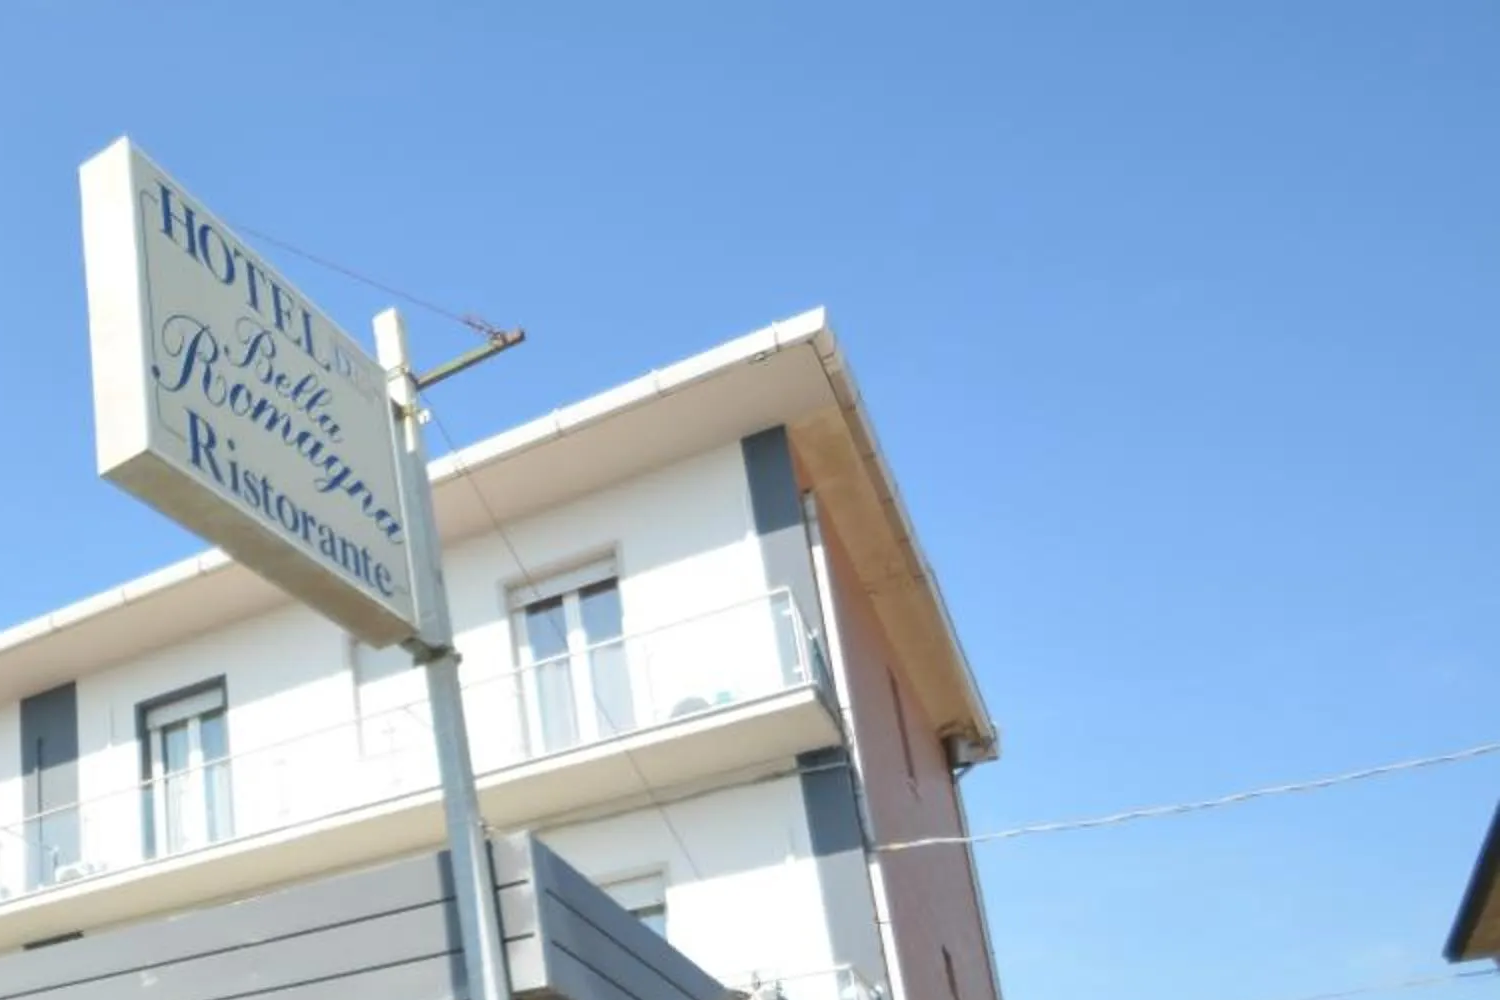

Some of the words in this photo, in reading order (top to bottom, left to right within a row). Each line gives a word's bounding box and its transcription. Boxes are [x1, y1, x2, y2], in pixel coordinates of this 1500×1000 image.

[155, 180, 331, 374] HOTEL
[151, 313, 407, 545] Romagna
[223, 315, 345, 445] Bella
[185, 406, 396, 598] Ristorante
